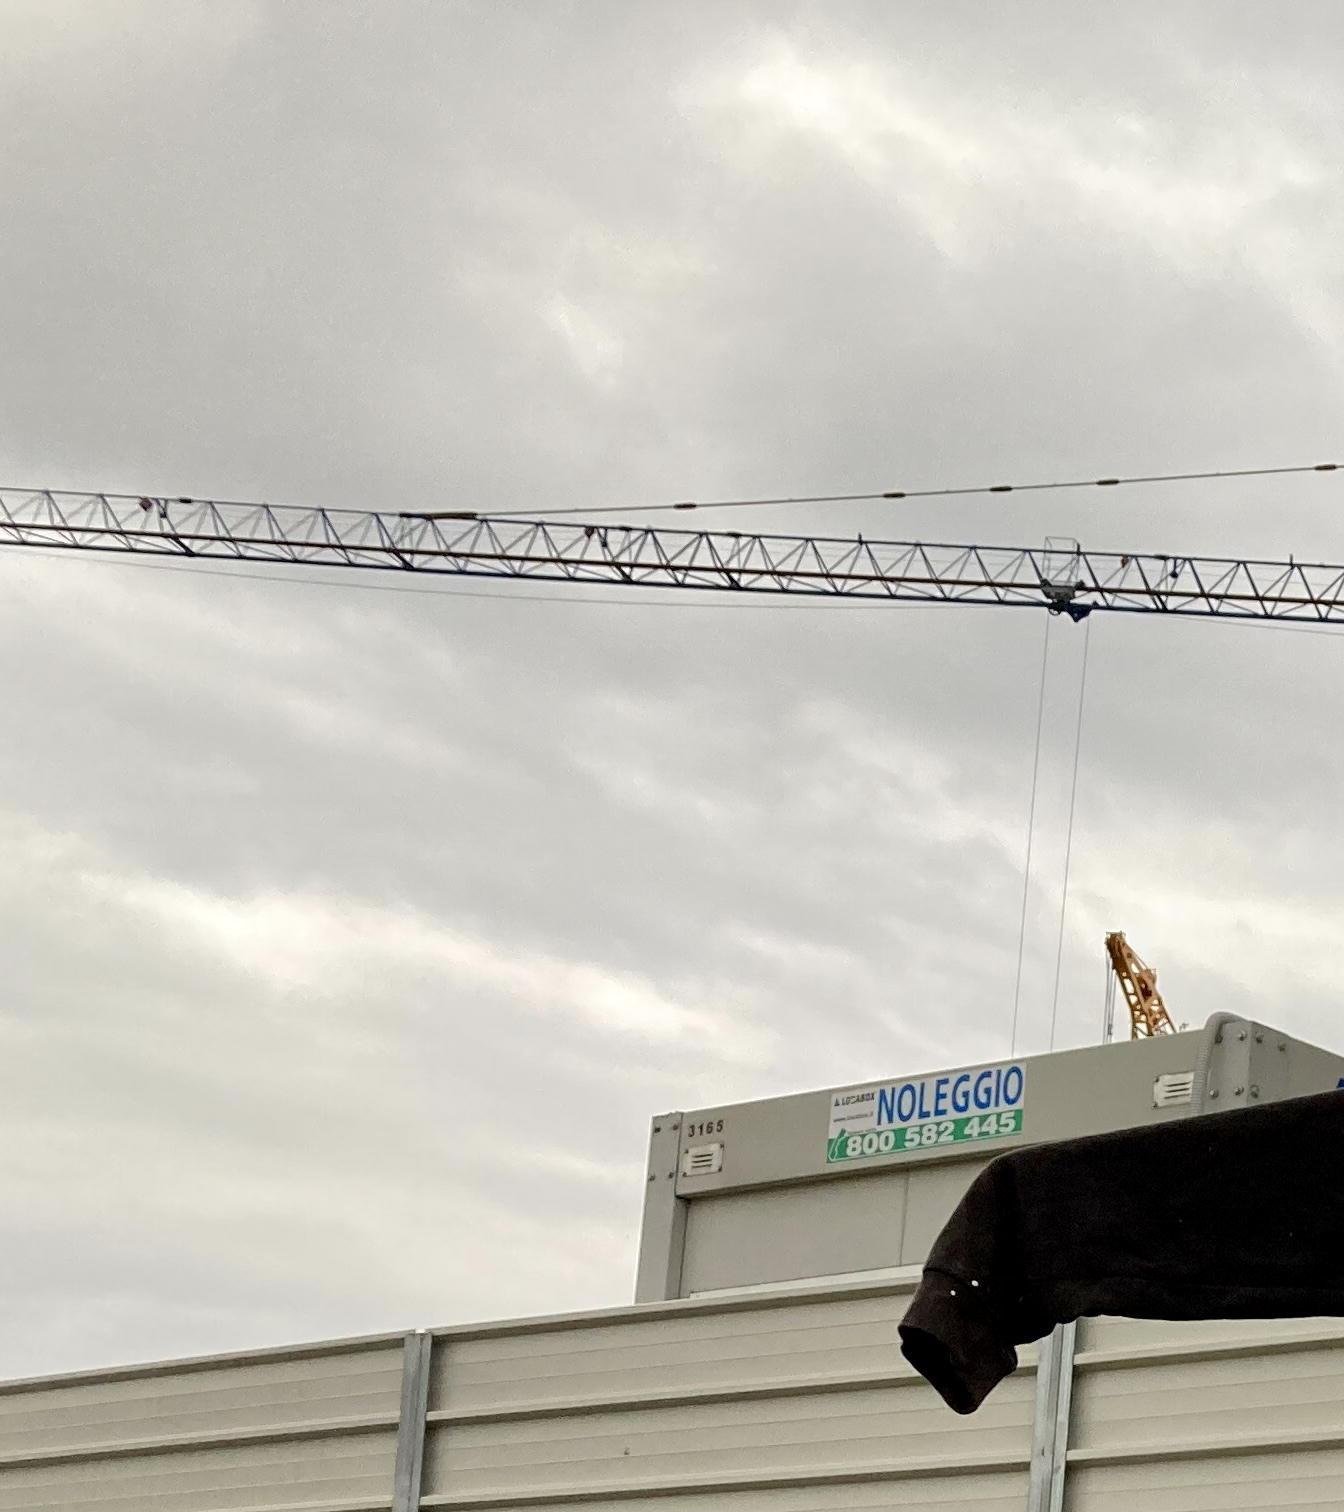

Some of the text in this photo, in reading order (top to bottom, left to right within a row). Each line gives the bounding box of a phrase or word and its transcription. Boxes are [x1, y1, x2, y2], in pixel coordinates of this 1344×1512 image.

[877, 1065, 1024, 1126] NOLEGGIO
[687, 1119, 725, 1138] 3165
[846, 1110, 1017, 1157] 800 582 445
